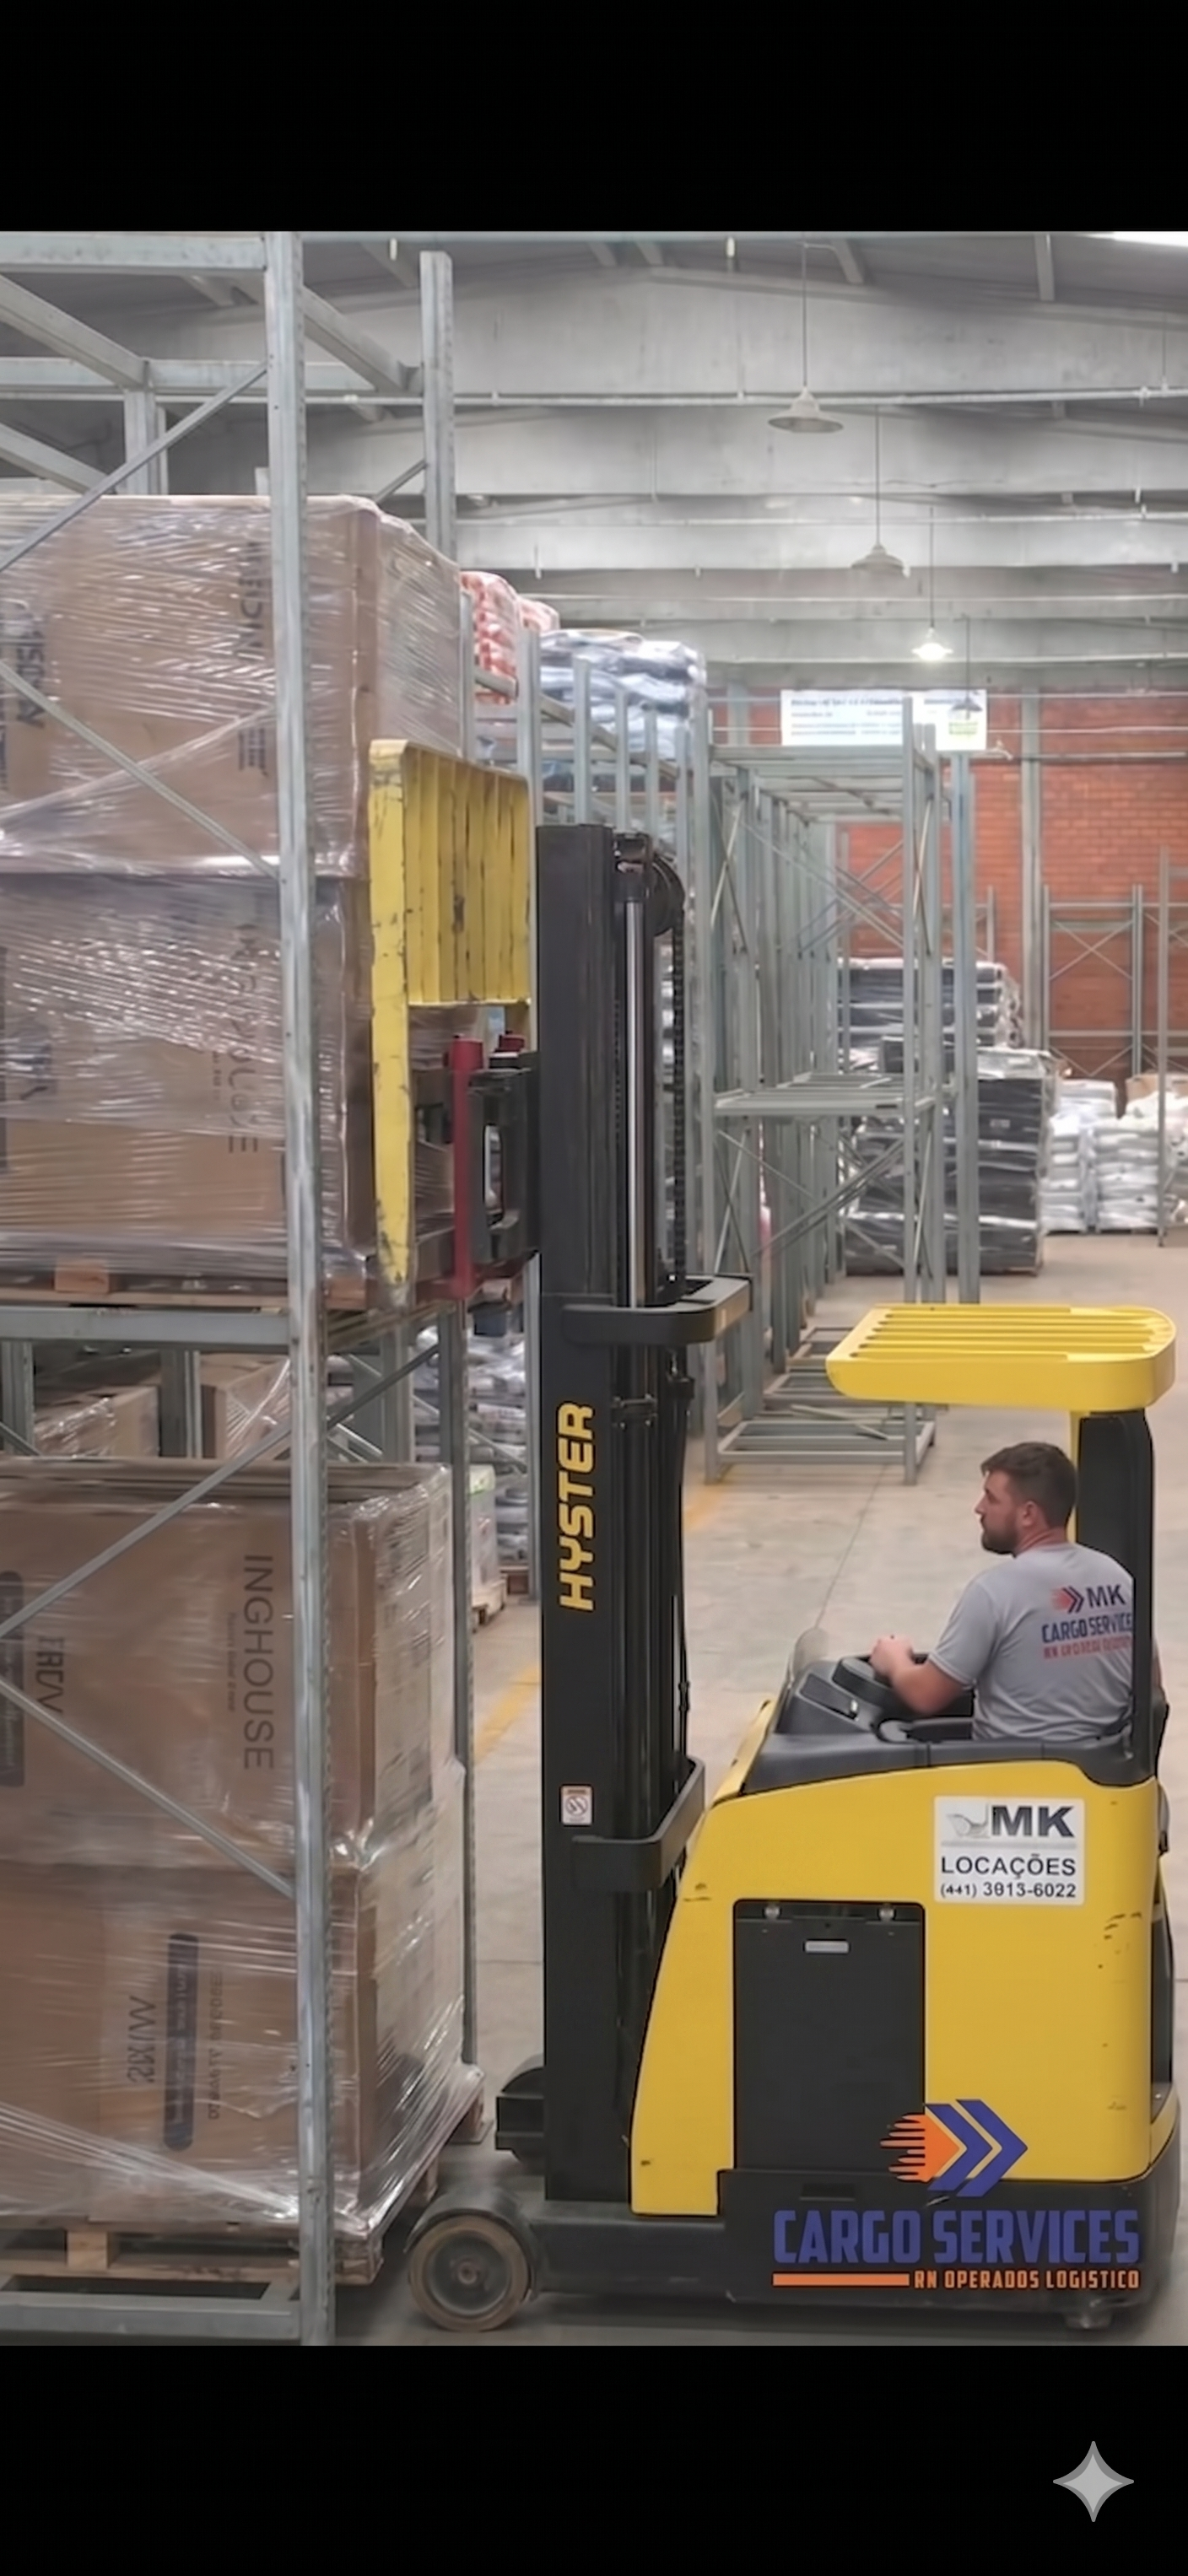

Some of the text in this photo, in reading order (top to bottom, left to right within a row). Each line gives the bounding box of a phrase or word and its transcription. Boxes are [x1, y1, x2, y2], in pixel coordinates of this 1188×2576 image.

[557, 1401, 594, 1612] HYSTER
[1086, 1584, 1126, 1608] MK
[1041, 1619, 1088, 1644] CARGO
[243, 1555, 274, 1770] INGHOUSE
[991, 1805, 1075, 1838] MK
[941, 1853, 1077, 1879] LOCAÇÕES
